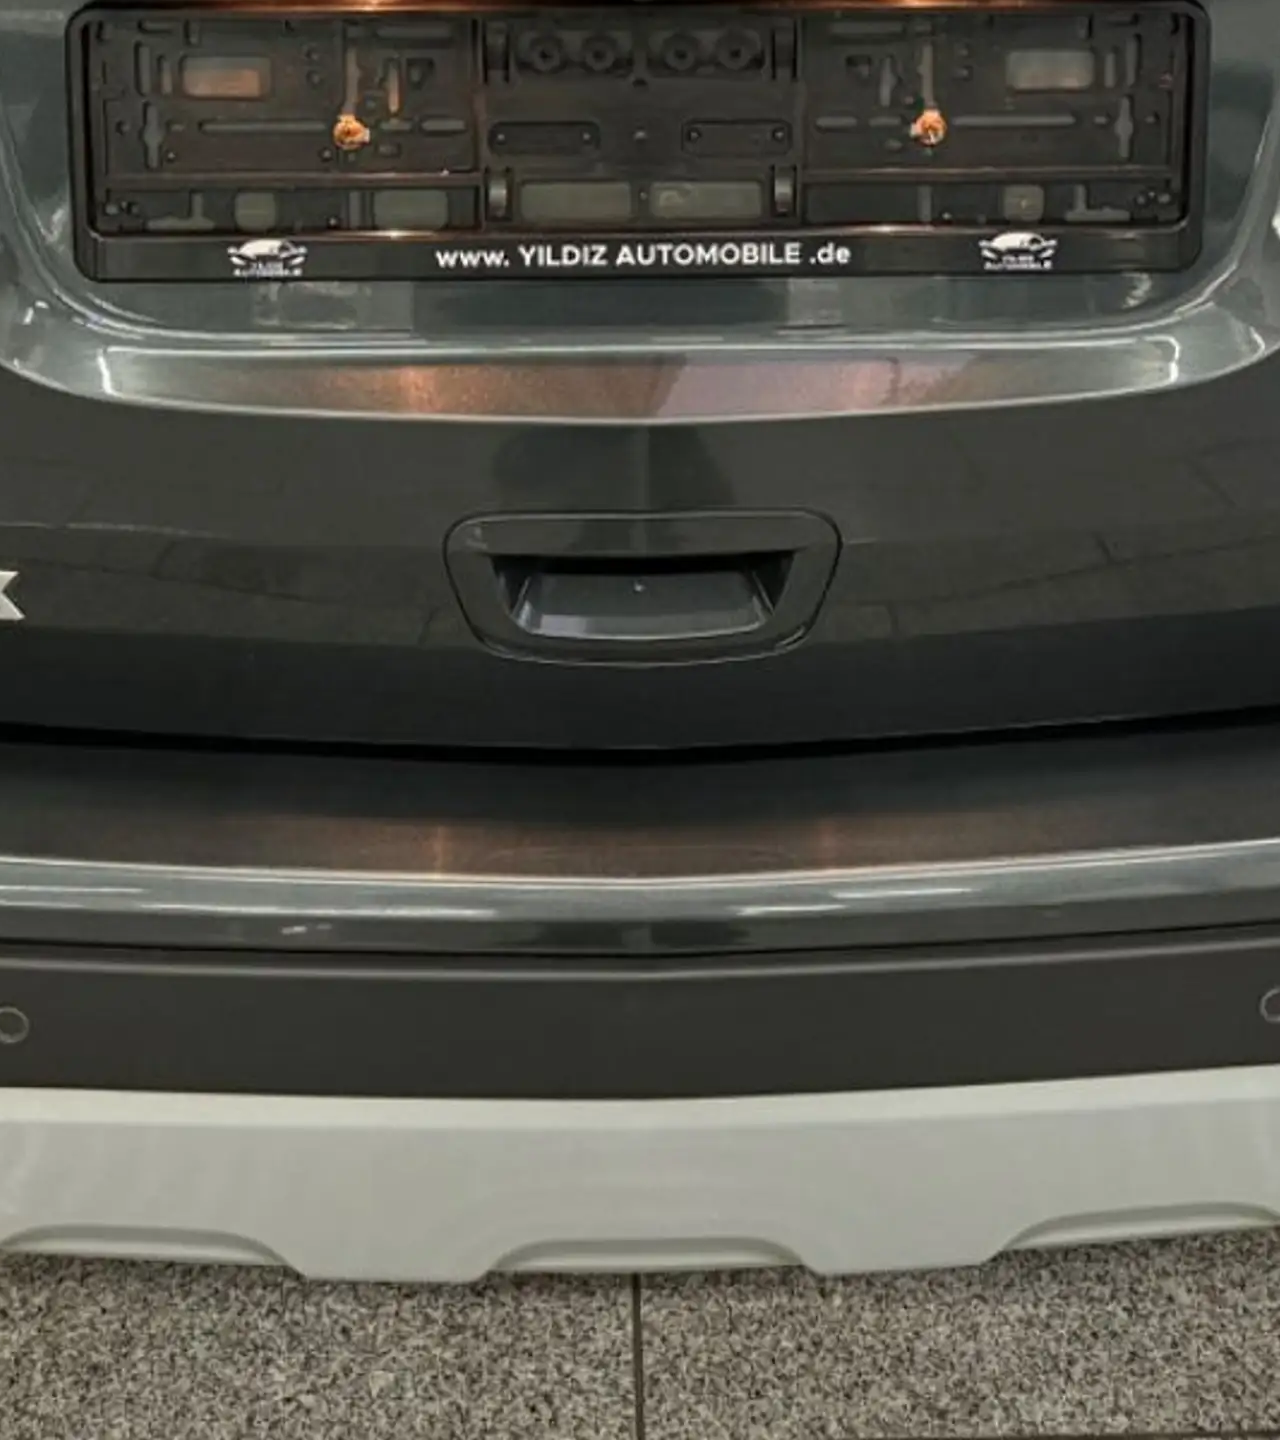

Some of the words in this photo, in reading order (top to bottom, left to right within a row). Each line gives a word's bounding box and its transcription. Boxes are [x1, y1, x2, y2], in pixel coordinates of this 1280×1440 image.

[435, 248, 510, 268] www.
[518, 244, 608, 267] YILDIZ
[616, 242, 802, 266] AUTOMOBILE
